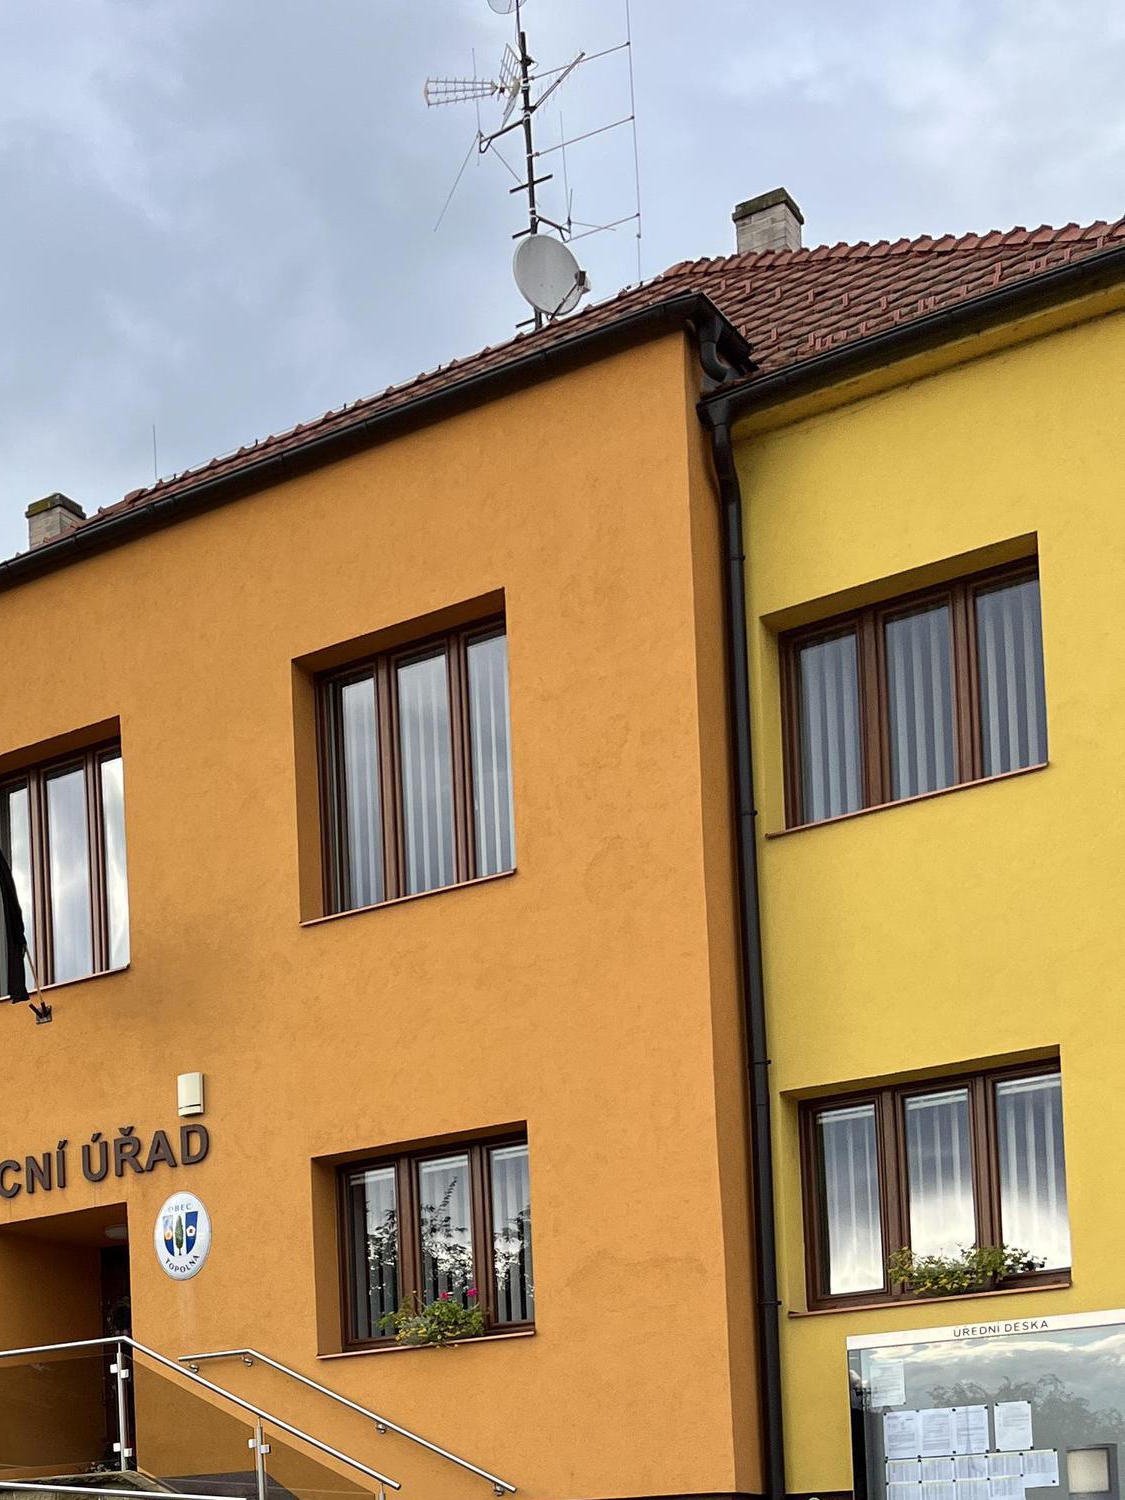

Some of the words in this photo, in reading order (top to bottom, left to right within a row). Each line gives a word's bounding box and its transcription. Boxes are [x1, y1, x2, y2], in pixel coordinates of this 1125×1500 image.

[82, 1124, 210, 1182] ÚŘAD
[168, 1203, 193, 1213] OBEC
[1004, 1320, 1049, 1332] DESKA
